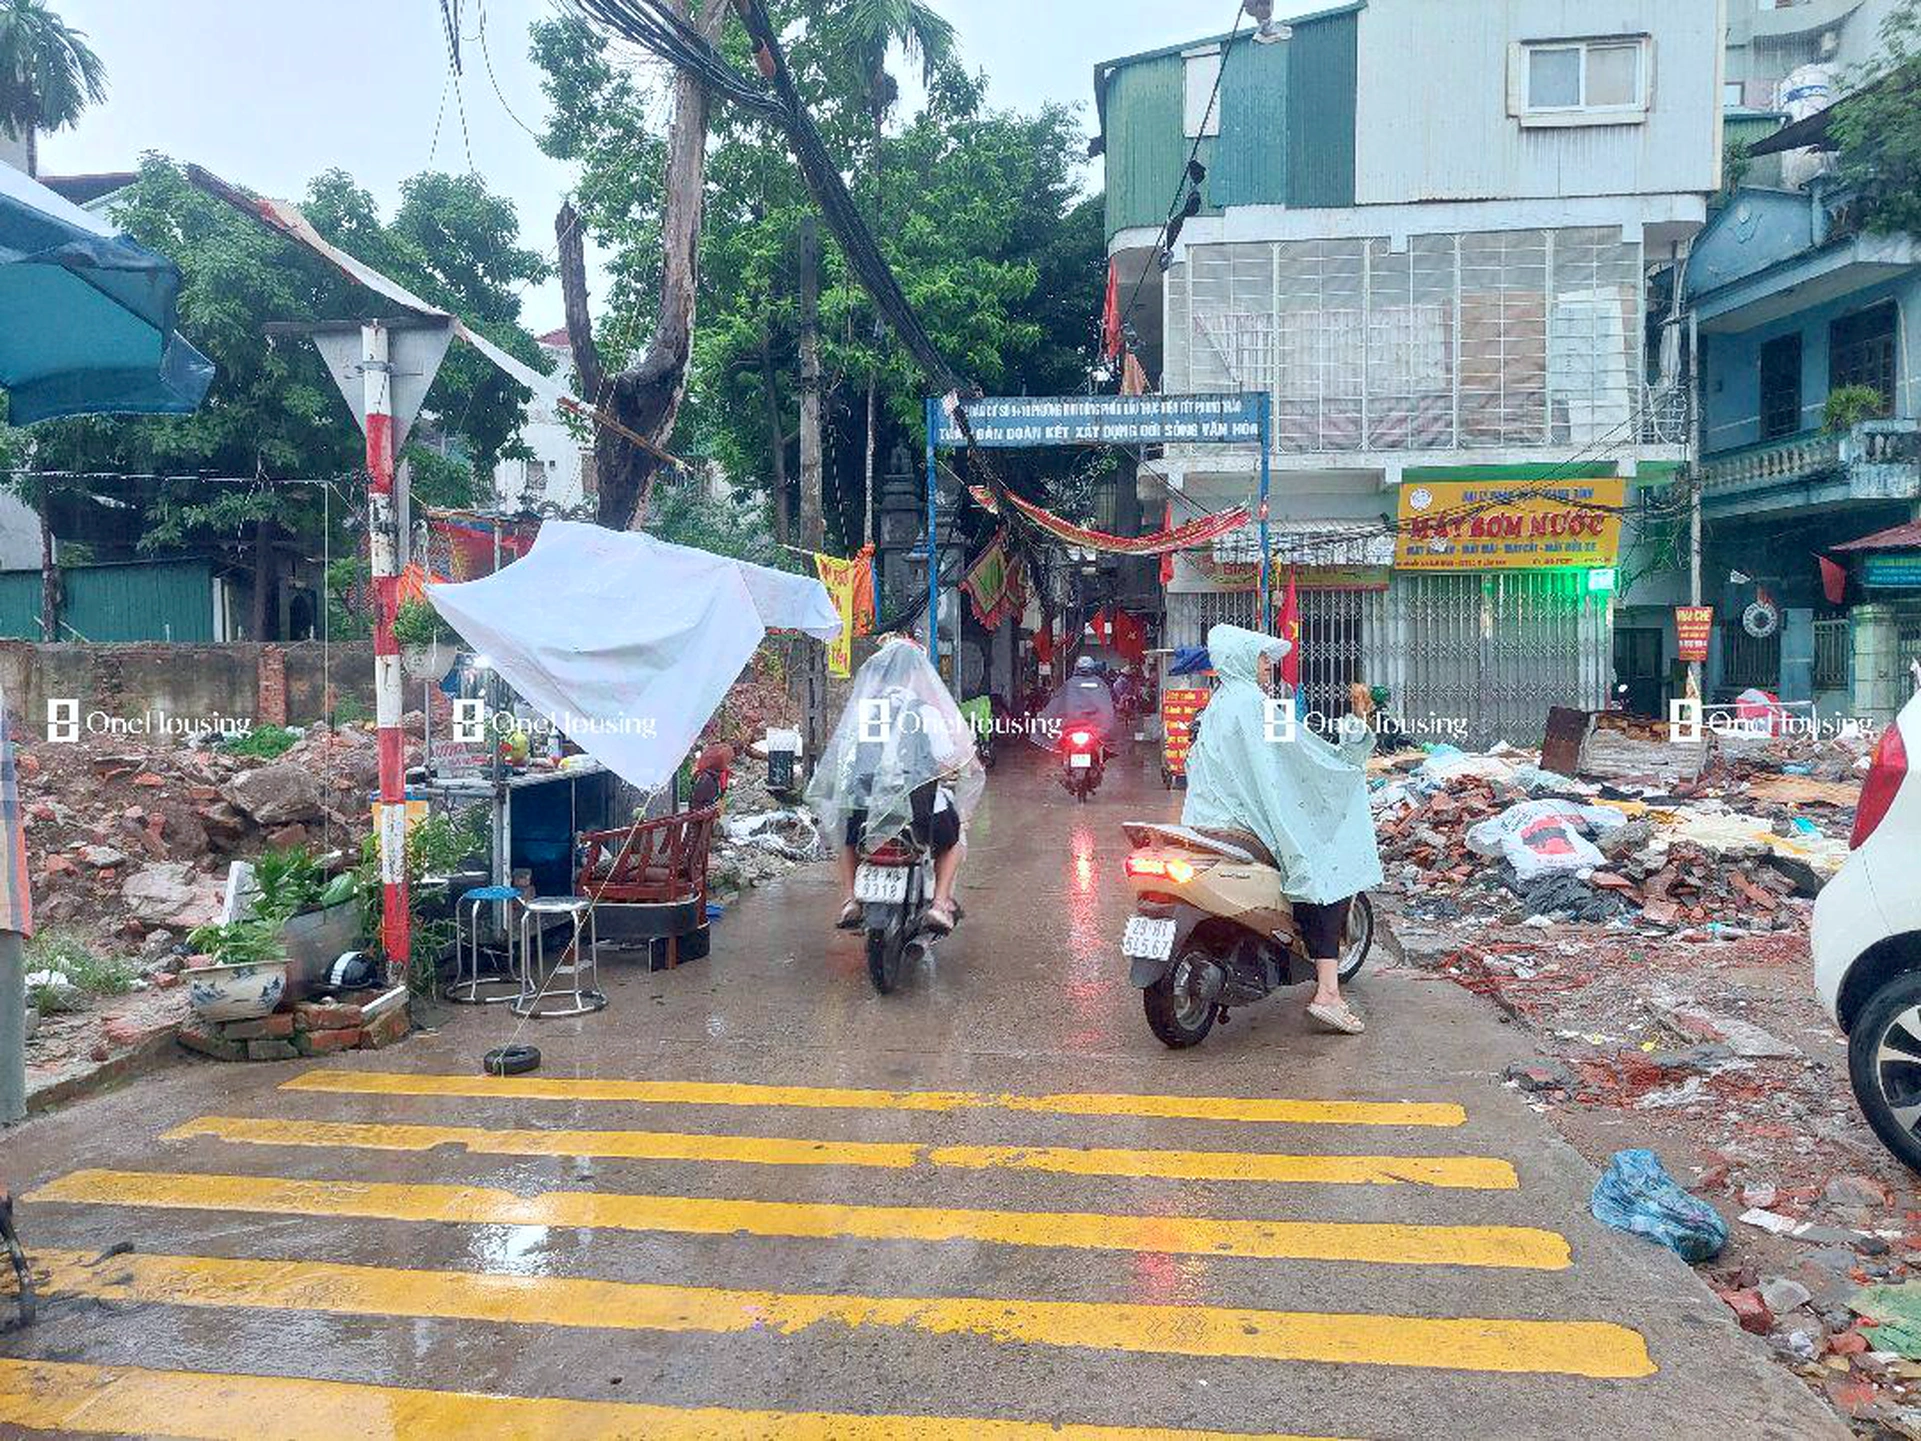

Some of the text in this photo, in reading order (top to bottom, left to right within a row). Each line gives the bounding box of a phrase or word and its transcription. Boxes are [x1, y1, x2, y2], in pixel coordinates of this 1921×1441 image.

[1045, 421, 1070, 439] KẾT
[1103, 423, 1138, 440] DỰNG
[1164, 420, 1198, 437] SỐNG
[1202, 420, 1228, 436] VĂN
[1530, 508, 1604, 538] NƯỚC
